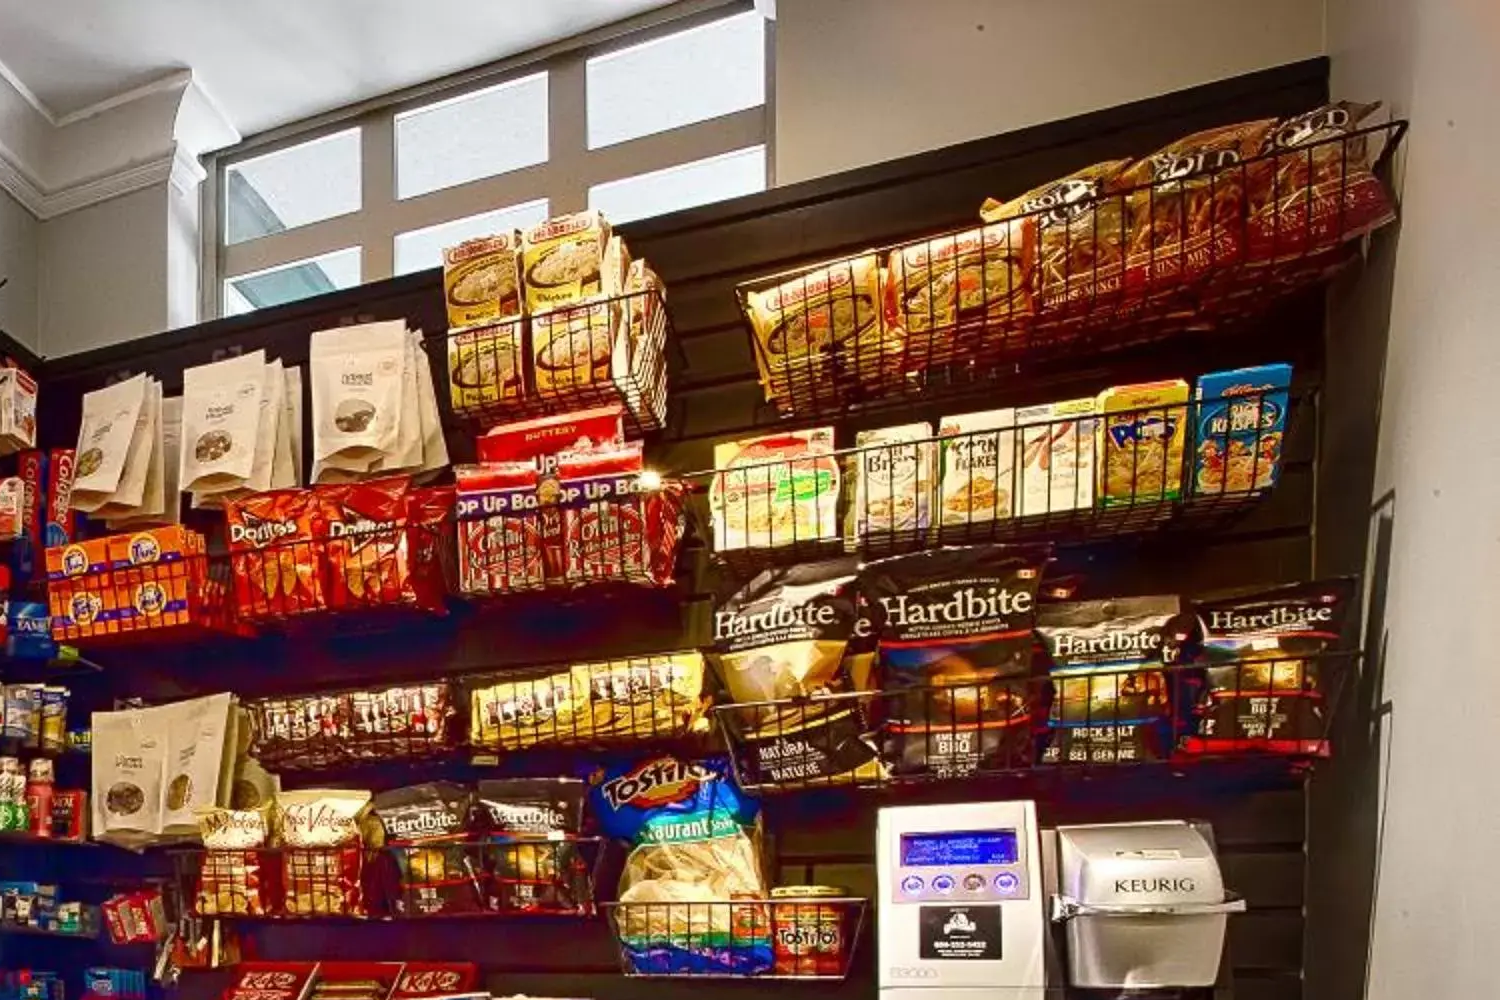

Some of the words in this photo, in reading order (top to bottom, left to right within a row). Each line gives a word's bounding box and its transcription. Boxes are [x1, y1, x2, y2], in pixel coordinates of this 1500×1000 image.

[524, 424, 578, 442] BUTTERY
[55, 452, 75, 525] Colgate
[230, 519, 298, 548] Doritos
[714, 600, 836, 641] Hardbite
[878, 587, 1033, 627] Hardbite
[1209, 606, 1333, 631] Hardbite
[1053, 630, 1162, 657] Hardbite
[383, 809, 457, 835] Hardbite
[1115, 878, 1195, 893] KEURIG
